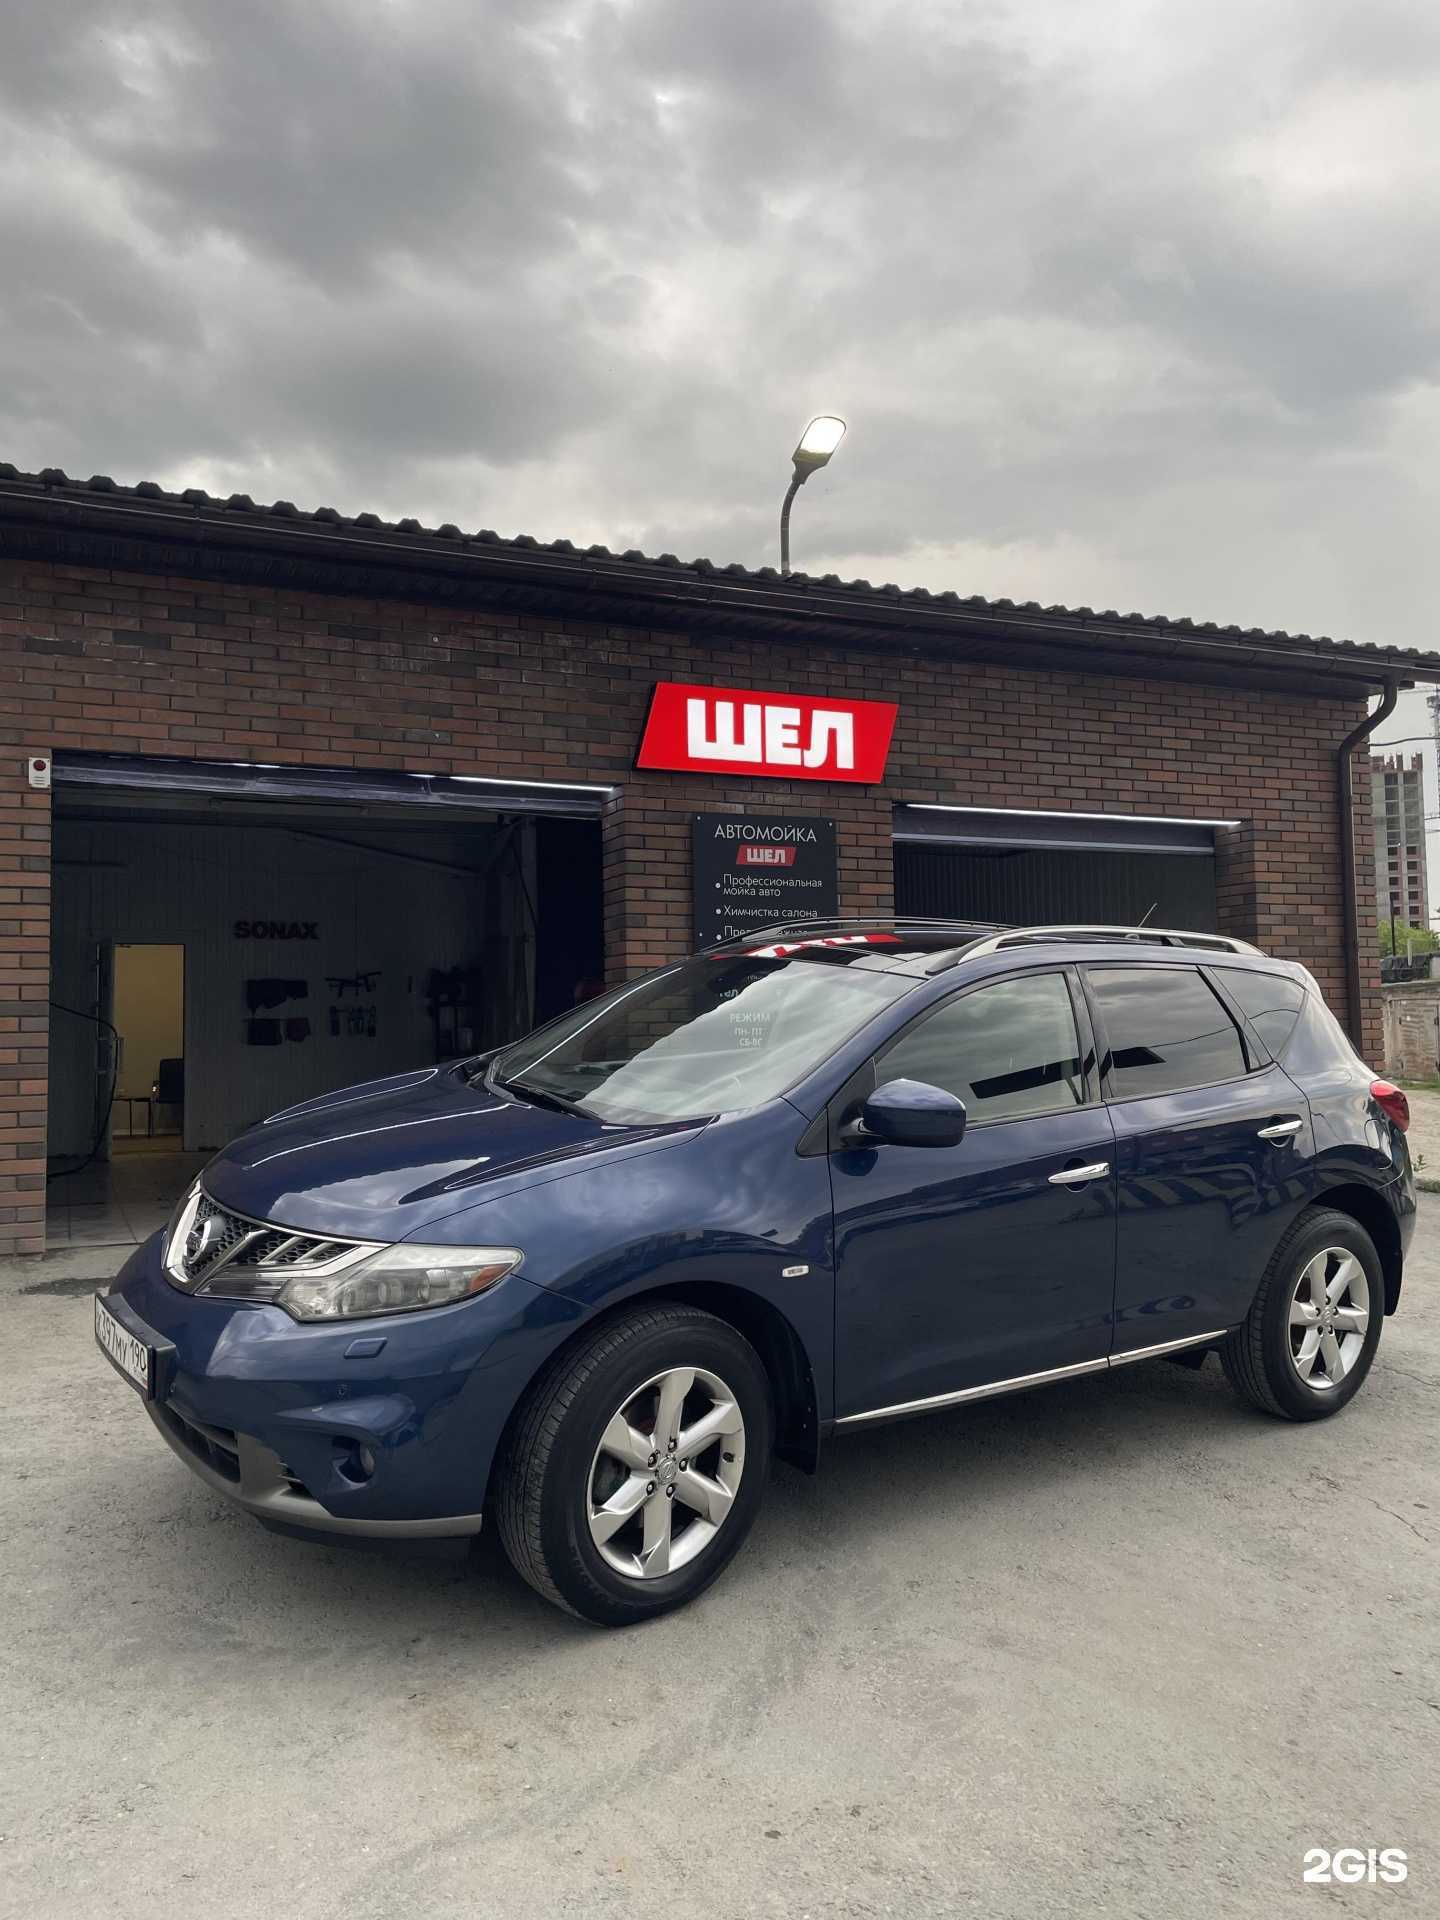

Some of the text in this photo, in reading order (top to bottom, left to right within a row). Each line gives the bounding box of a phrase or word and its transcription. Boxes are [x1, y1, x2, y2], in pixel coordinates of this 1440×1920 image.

[687, 698, 855, 769] ШЕЛ
[714, 824, 817, 842] АВТОМОЙКА
[746, 848, 786, 863] ШЕЛ
[723, 874, 823, 889] Профессиональная
[723, 887, 781, 897] мойка авто
[724, 905, 818, 918] Химчистка салона
[232, 920, 320, 939] SONAX
